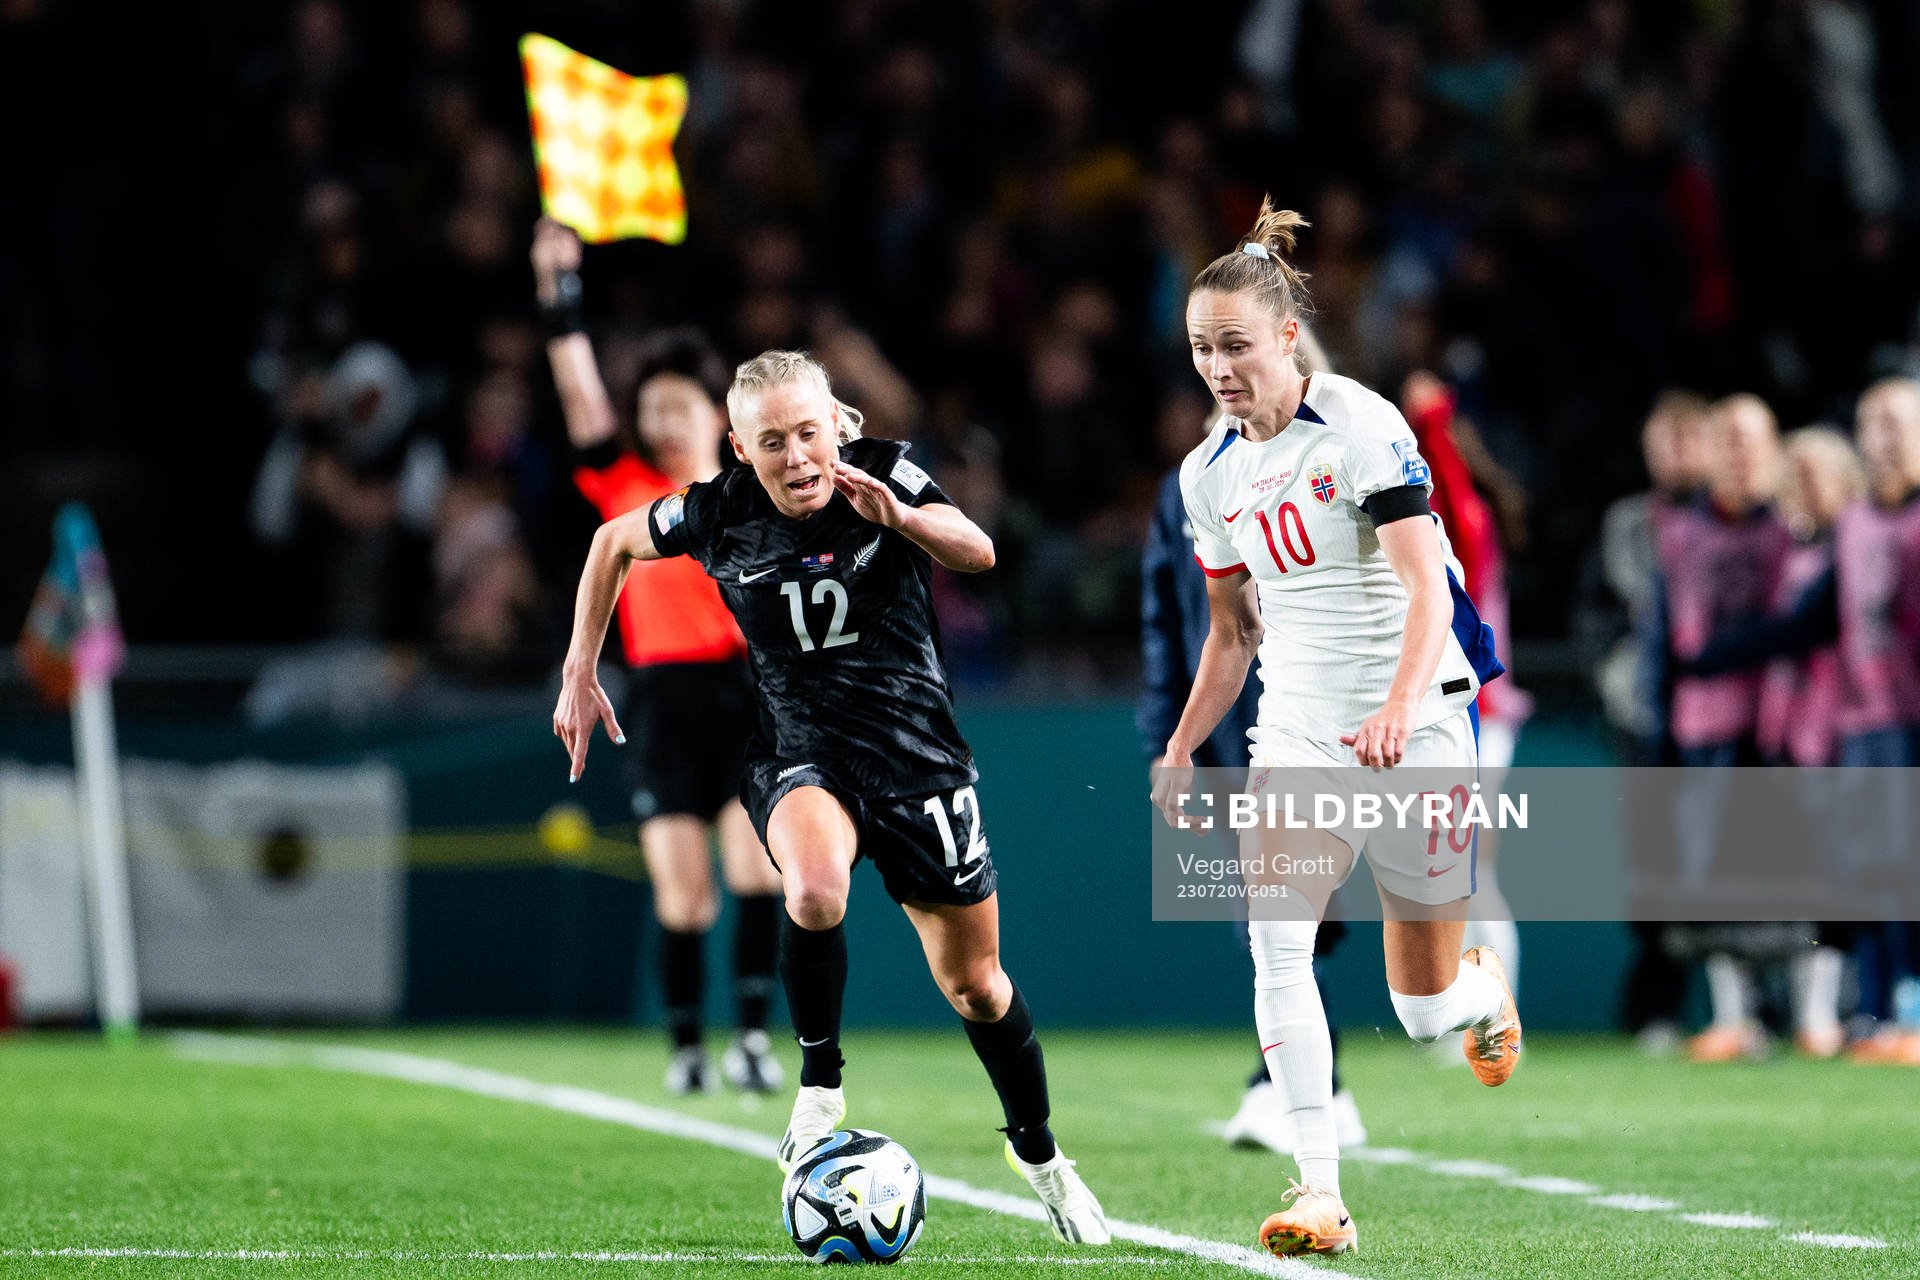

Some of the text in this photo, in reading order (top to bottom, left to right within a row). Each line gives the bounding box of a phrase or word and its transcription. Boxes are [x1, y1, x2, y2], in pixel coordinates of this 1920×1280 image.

[1254, 501, 1316, 574] 10
[779, 578, 859, 652] 12
[923, 784, 987, 868] 12
[1419, 783, 1471, 855] 10
